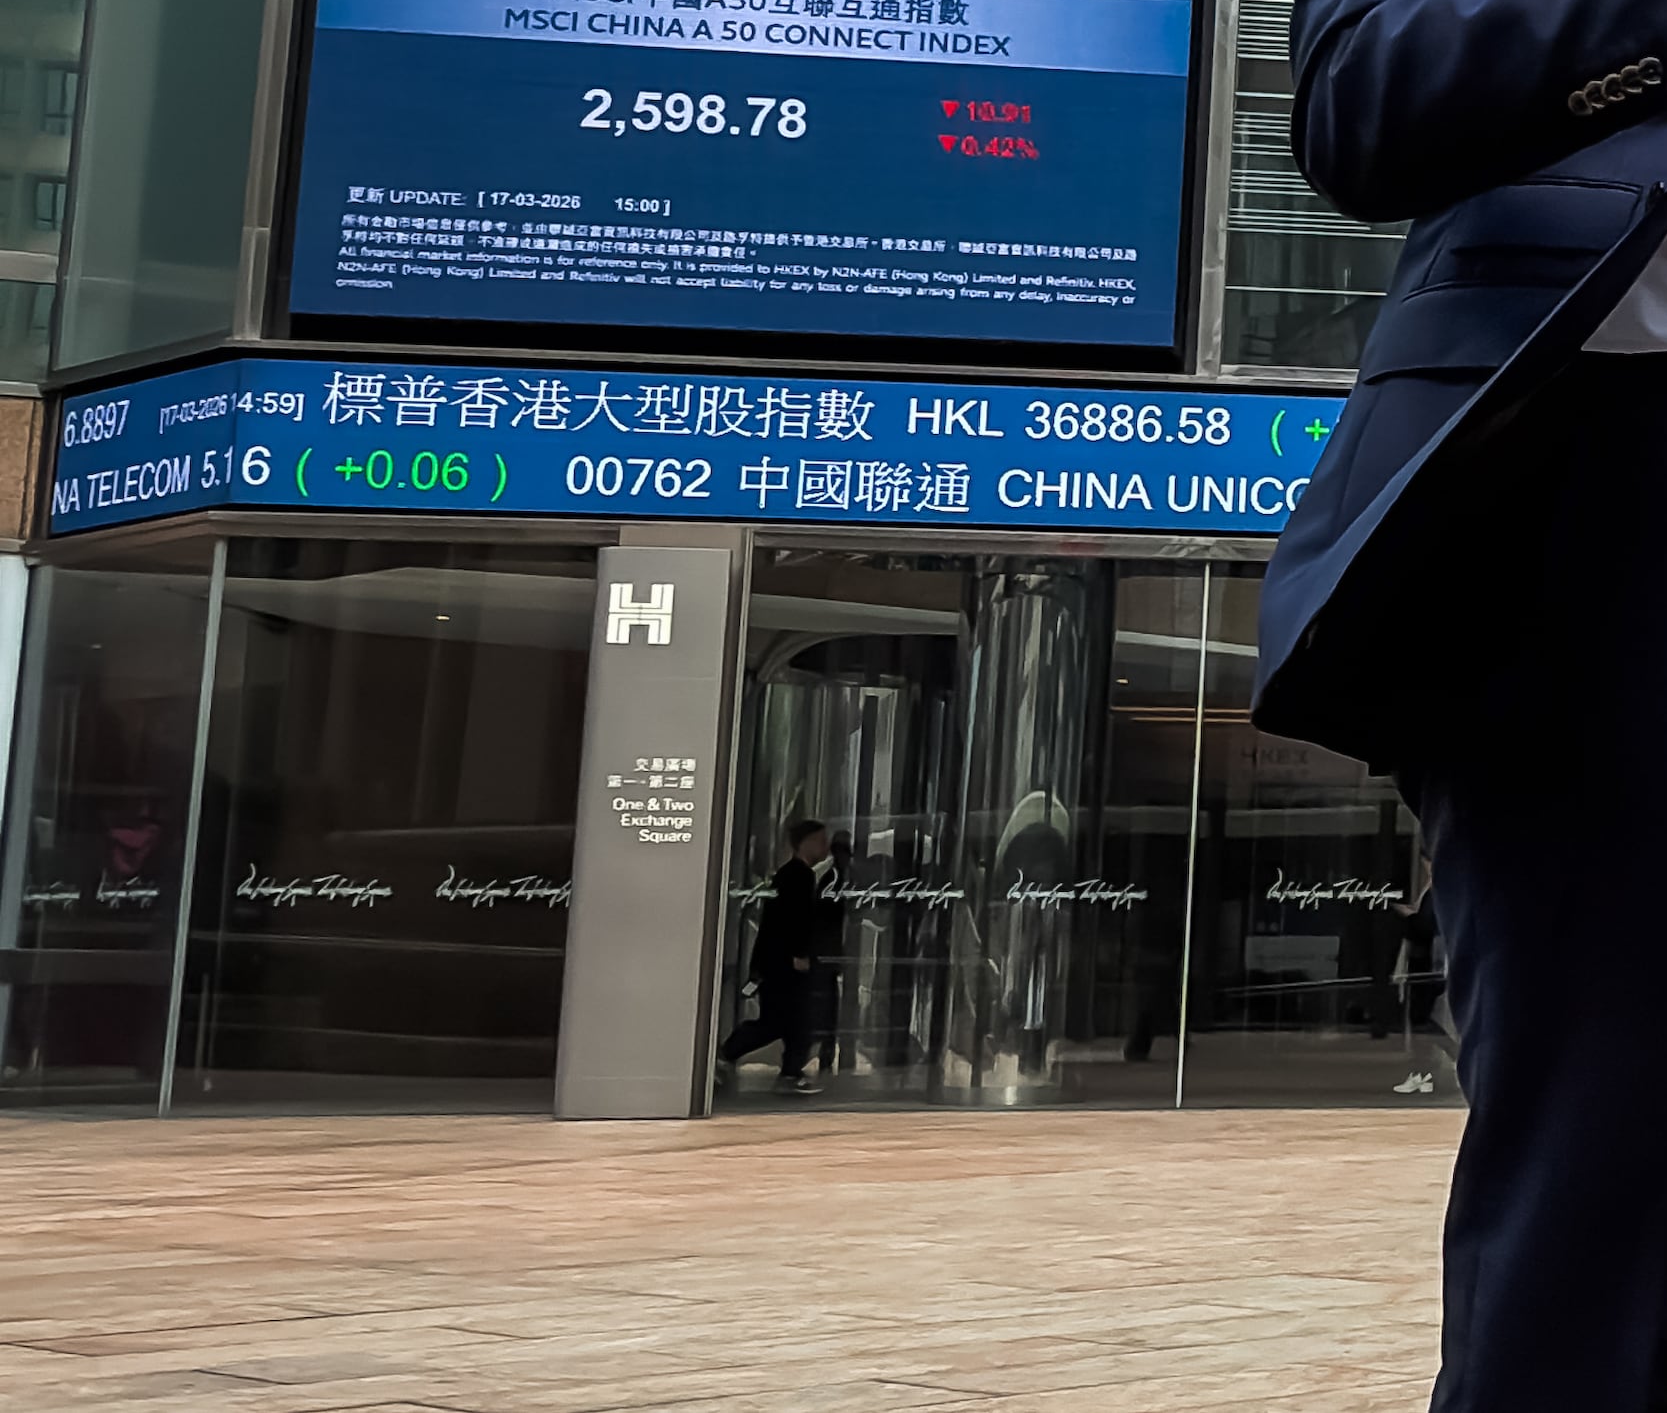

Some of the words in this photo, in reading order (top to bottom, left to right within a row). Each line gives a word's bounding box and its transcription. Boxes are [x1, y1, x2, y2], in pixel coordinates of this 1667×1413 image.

[505, 9, 578, 31] MSCI
[588, 13, 684, 38] CHINA
[692, 19, 714, 40] A
[721, 20, 757, 43] 50
[765, 24, 914, 51] CONNECT
[920, 32, 1011, 56] INDEX
[581, 89, 806, 138] 2,598.78
[614, 197, 660, 213] 15:00
[64, 400, 130, 447] 6.8897
[231, 392, 304, 421] 14:59]
[323, 371, 875, 440] 標普香港大型股指數
[908, 398, 1004, 436] HKL
[1025, 401, 1230, 445] 36886.58
[51, 478, 80, 515] NA
[87, 455, 190, 508] TELECOM
[201, 446, 271, 488] 5.16
[335, 450, 468, 490] +0.06
[567, 456, 711, 497] 00762
[740, 456, 970, 512] 中國聯通
[998, 470, 1153, 509] CHINA
[612, 797, 646, 811] One
[646, 797, 661, 811] &
[662, 797, 695, 812] Two
[620, 812, 693, 830] Exchange
[638, 828, 692, 844] Square
